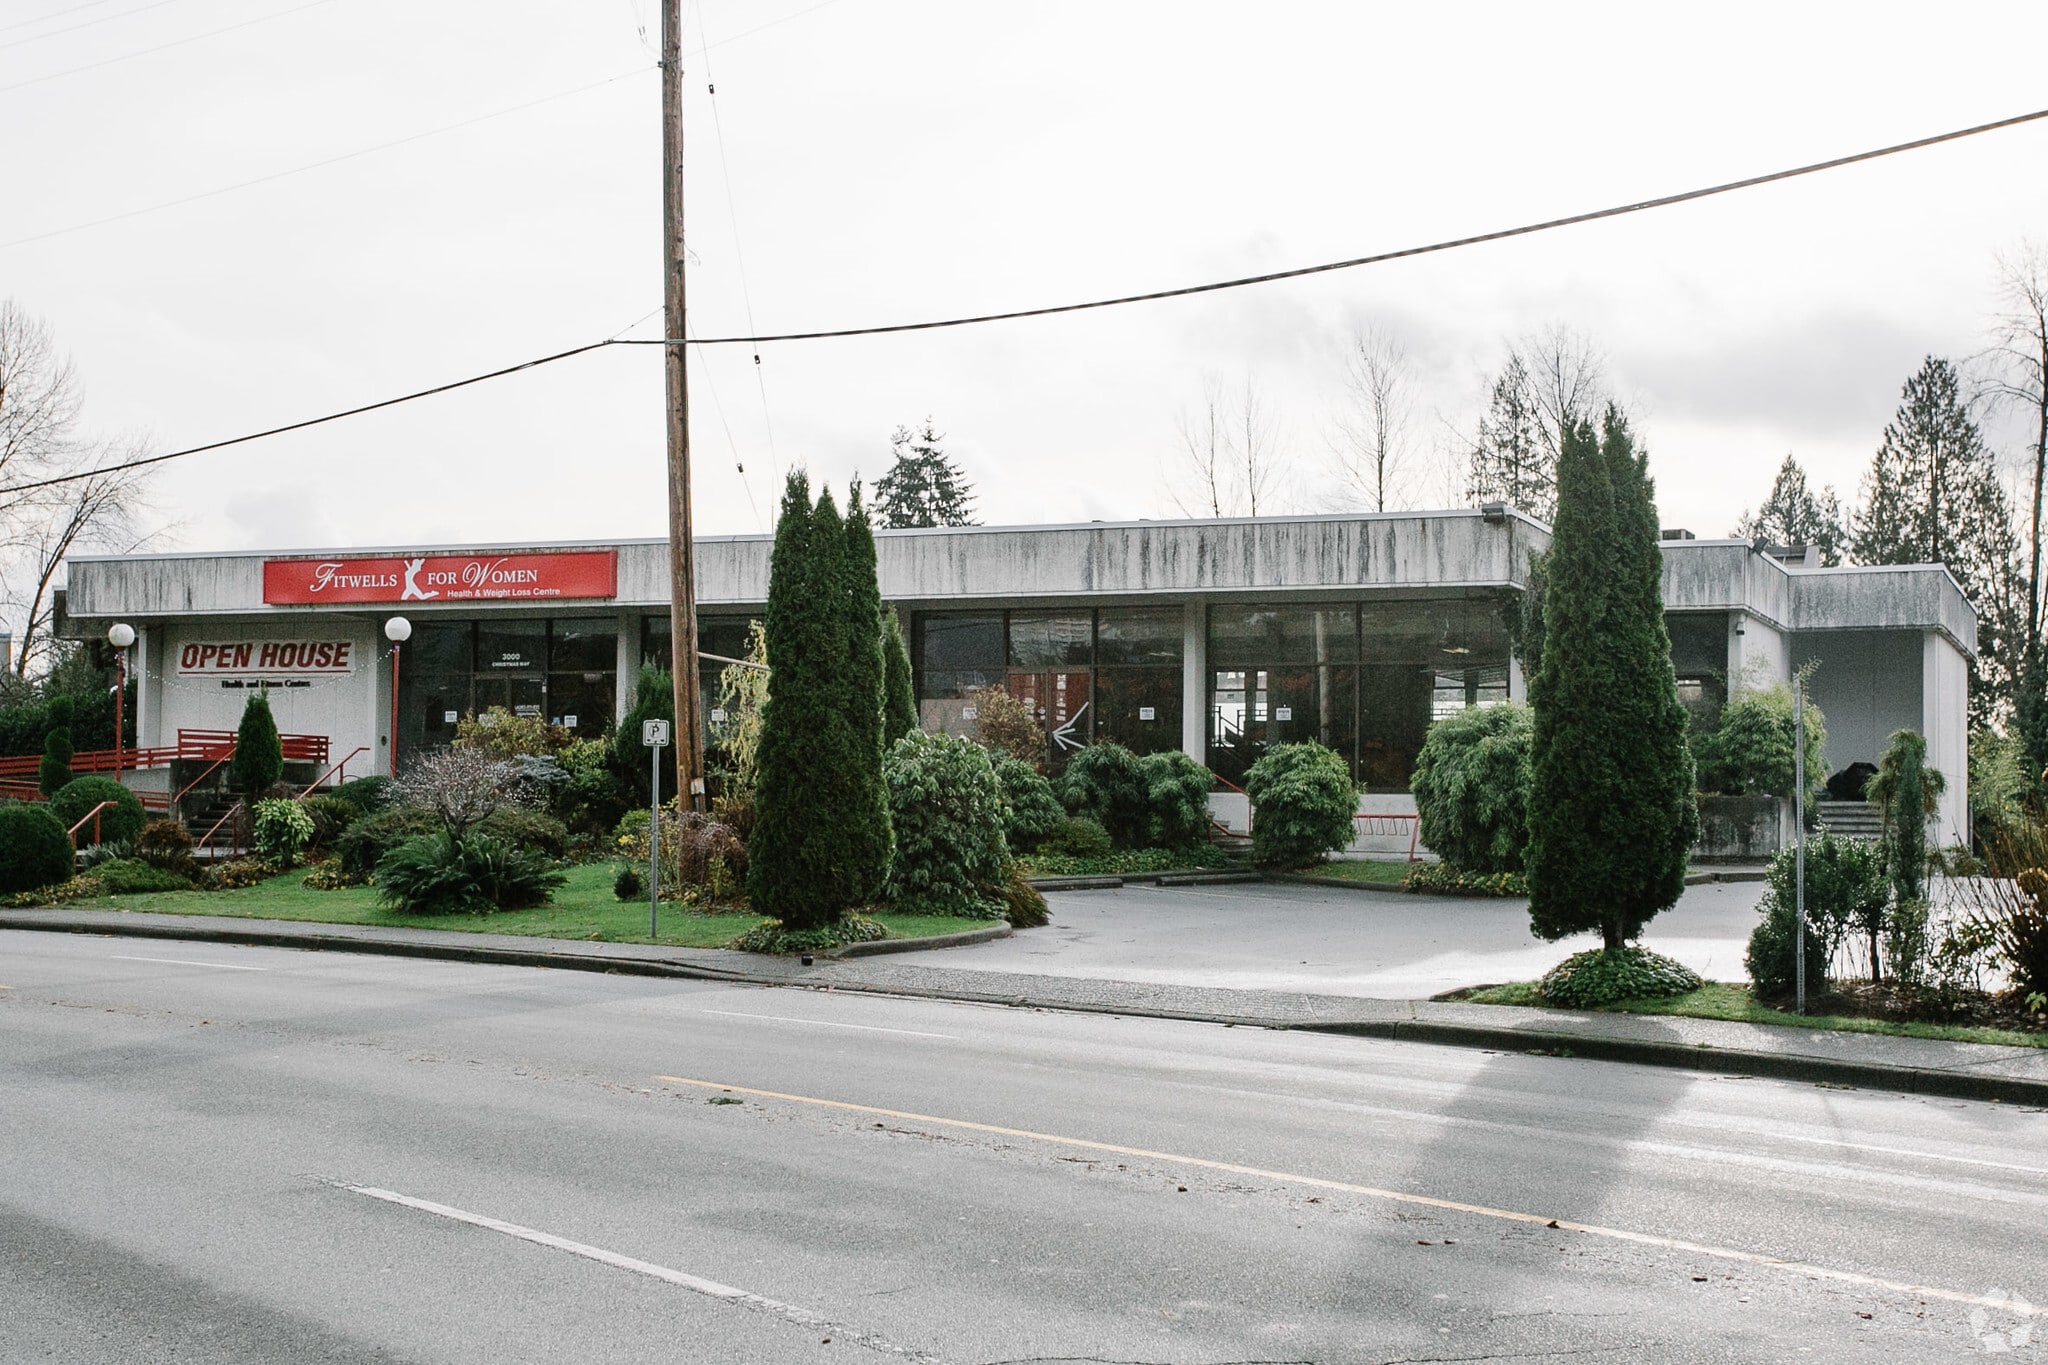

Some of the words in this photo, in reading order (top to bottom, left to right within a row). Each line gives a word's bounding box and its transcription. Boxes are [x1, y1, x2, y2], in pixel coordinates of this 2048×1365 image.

[427, 572, 457, 585] FOR
[447, 589, 473, 598] Health
[475, 589, 481, 597] &
[483, 588, 510, 598] Weight
[512, 588, 531, 596] Loss
[533, 587, 561, 596] Centre
[181, 644, 253, 669] OPEN
[259, 642, 353, 668] HOUSE
[221, 680, 244, 688] Health
[246, 680, 259, 688] and
